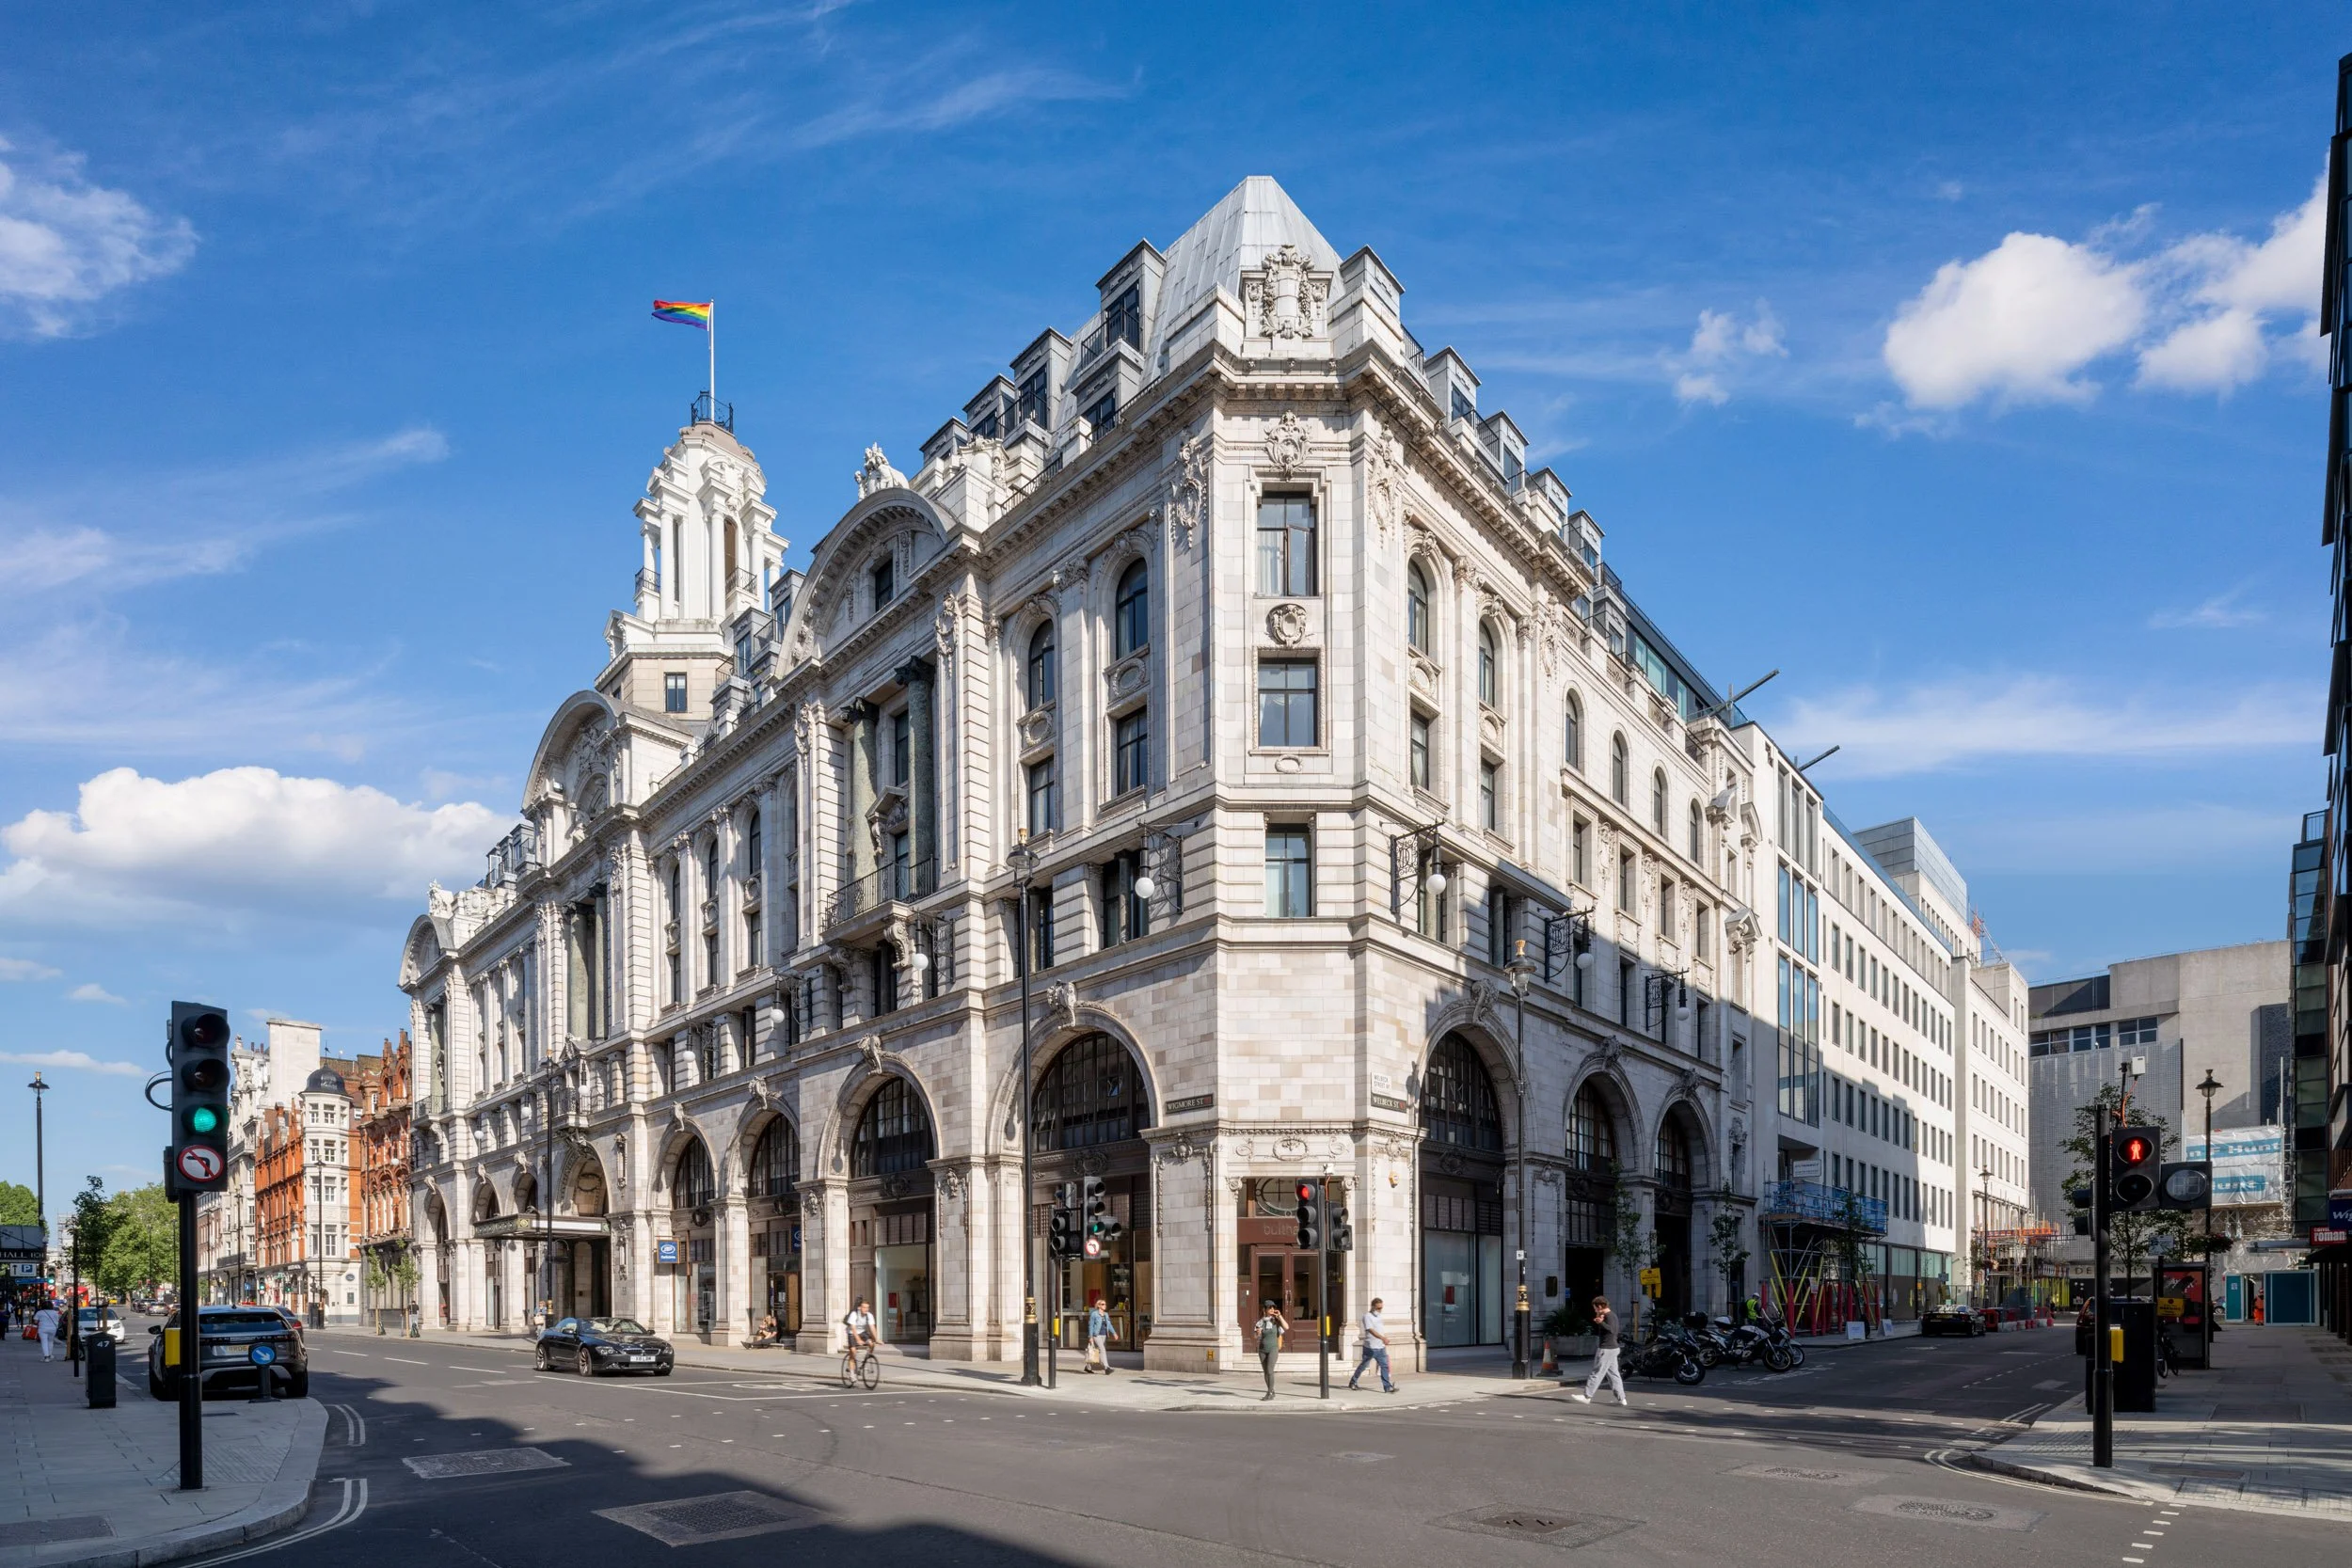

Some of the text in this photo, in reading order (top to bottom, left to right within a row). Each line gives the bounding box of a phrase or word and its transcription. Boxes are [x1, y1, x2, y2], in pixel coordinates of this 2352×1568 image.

[1168, 1100, 1196, 1110] WIGMORE
[1373, 1096, 1393, 1107] WELBECK
[2228, 1142, 2280, 1154] Hunt
[1263, 1223, 1299, 1235] bultha
